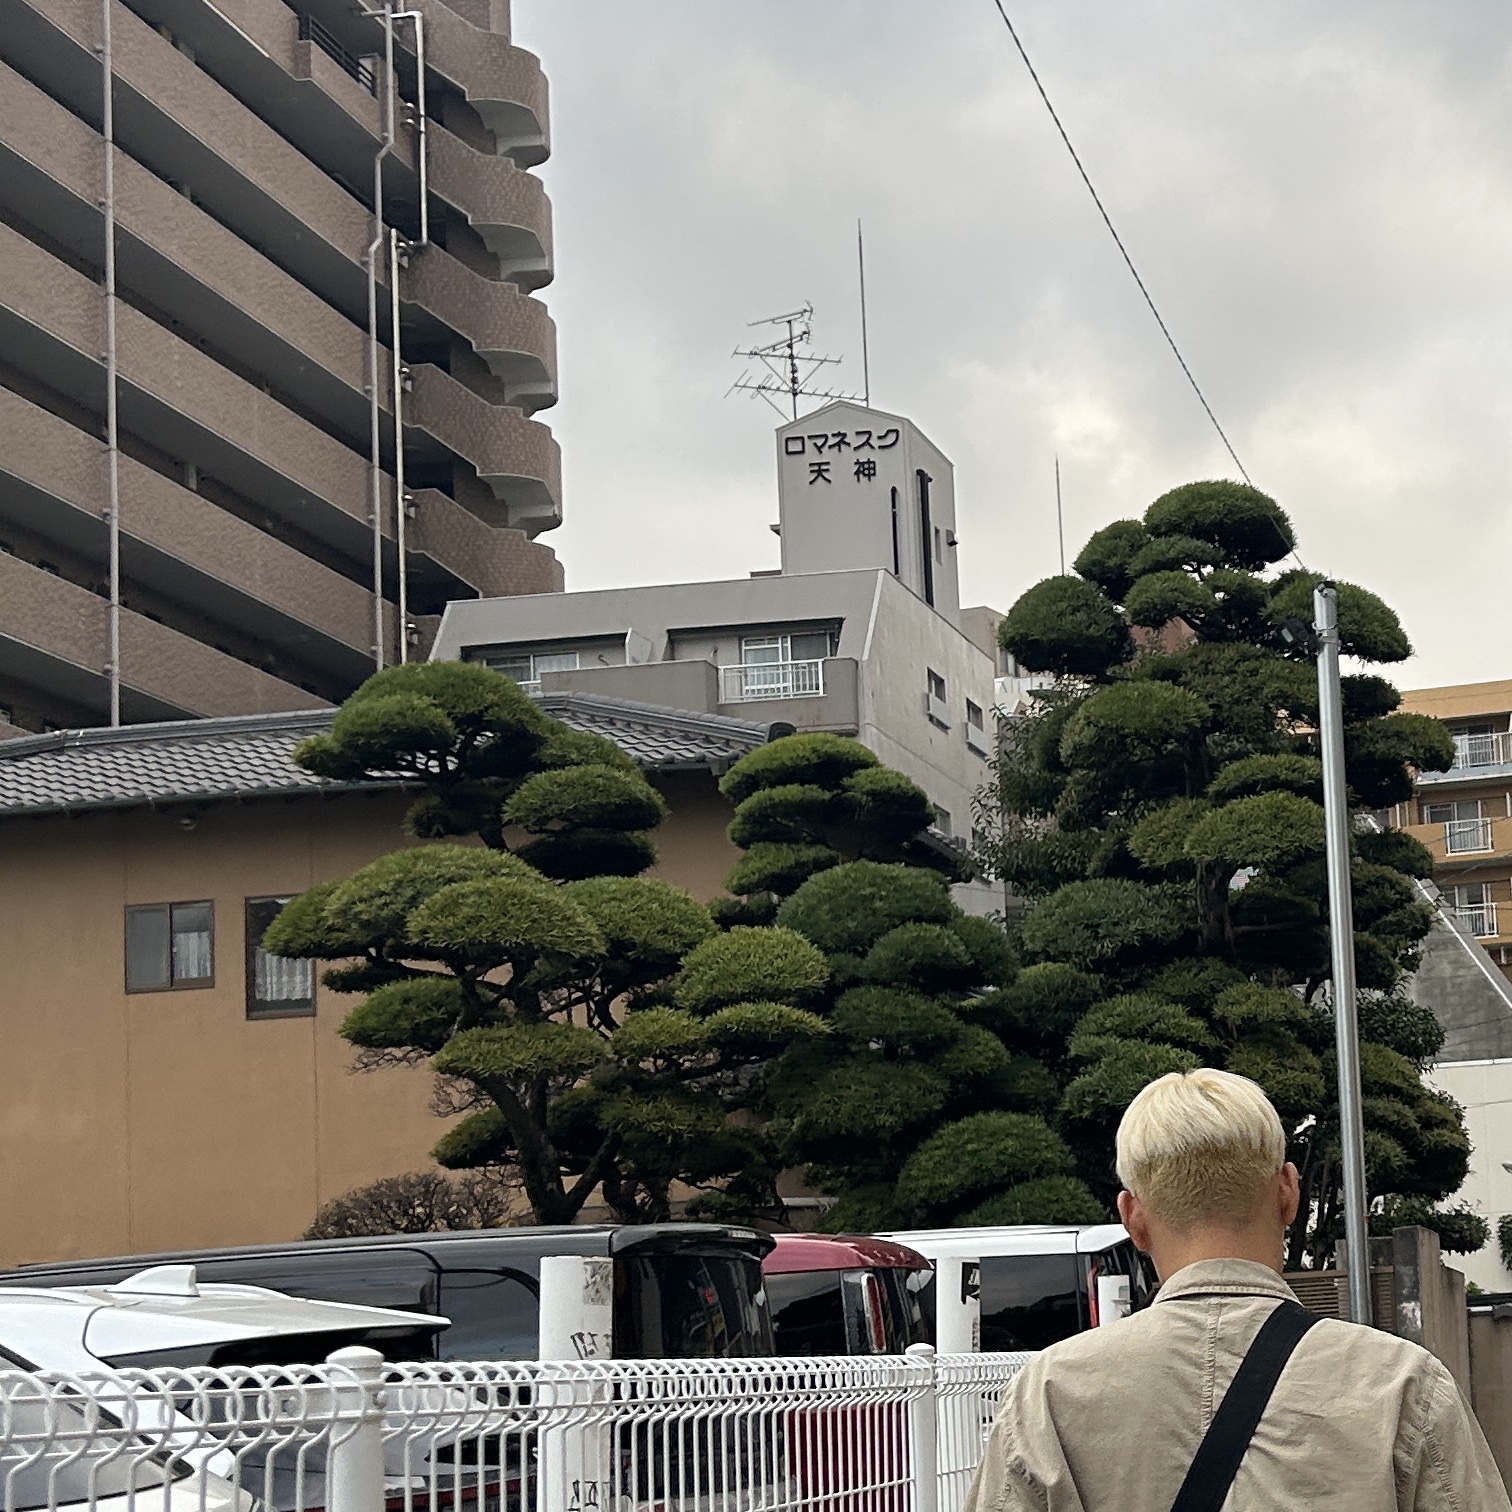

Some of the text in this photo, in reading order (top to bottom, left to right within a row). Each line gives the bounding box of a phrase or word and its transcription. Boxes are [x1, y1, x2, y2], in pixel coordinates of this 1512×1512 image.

[785, 429, 899, 455] ロマネスク
[808, 458, 876, 485] 天神
